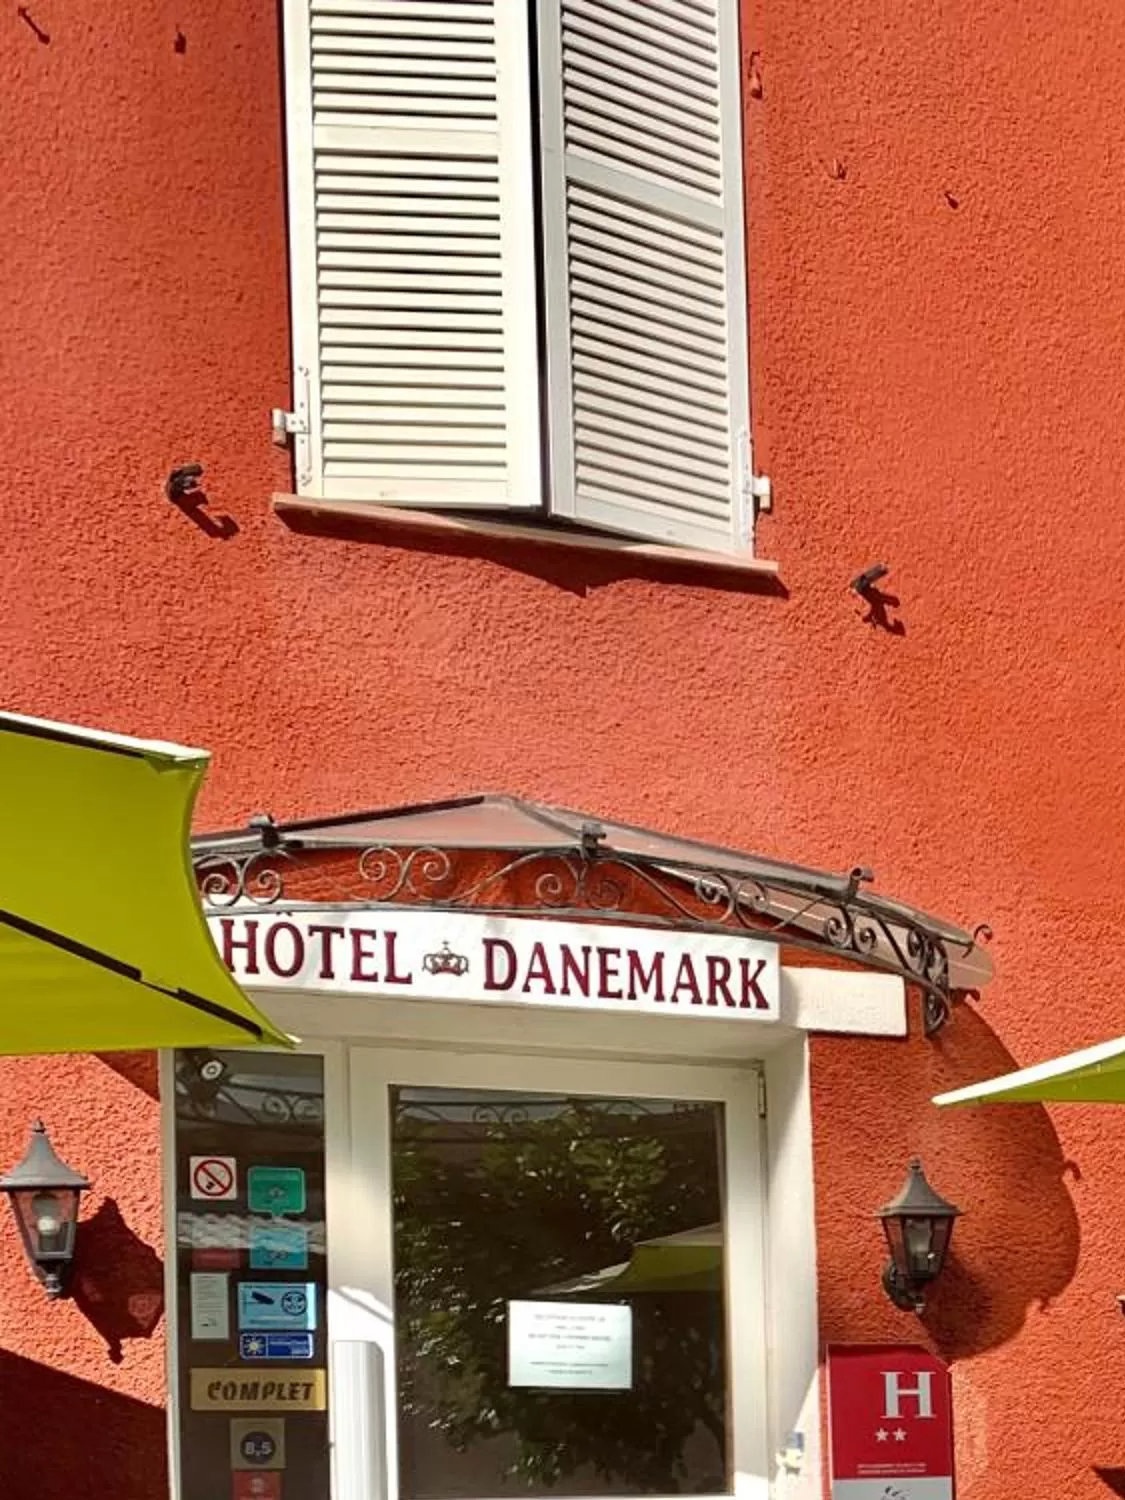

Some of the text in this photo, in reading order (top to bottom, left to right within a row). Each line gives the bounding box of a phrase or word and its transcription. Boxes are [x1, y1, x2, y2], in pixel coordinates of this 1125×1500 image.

[220, 911, 770, 1010] HÔTEL DANEMARK
[207, 1380, 314, 1400] COMPLET
[880, 1371, 936, 1418] H
